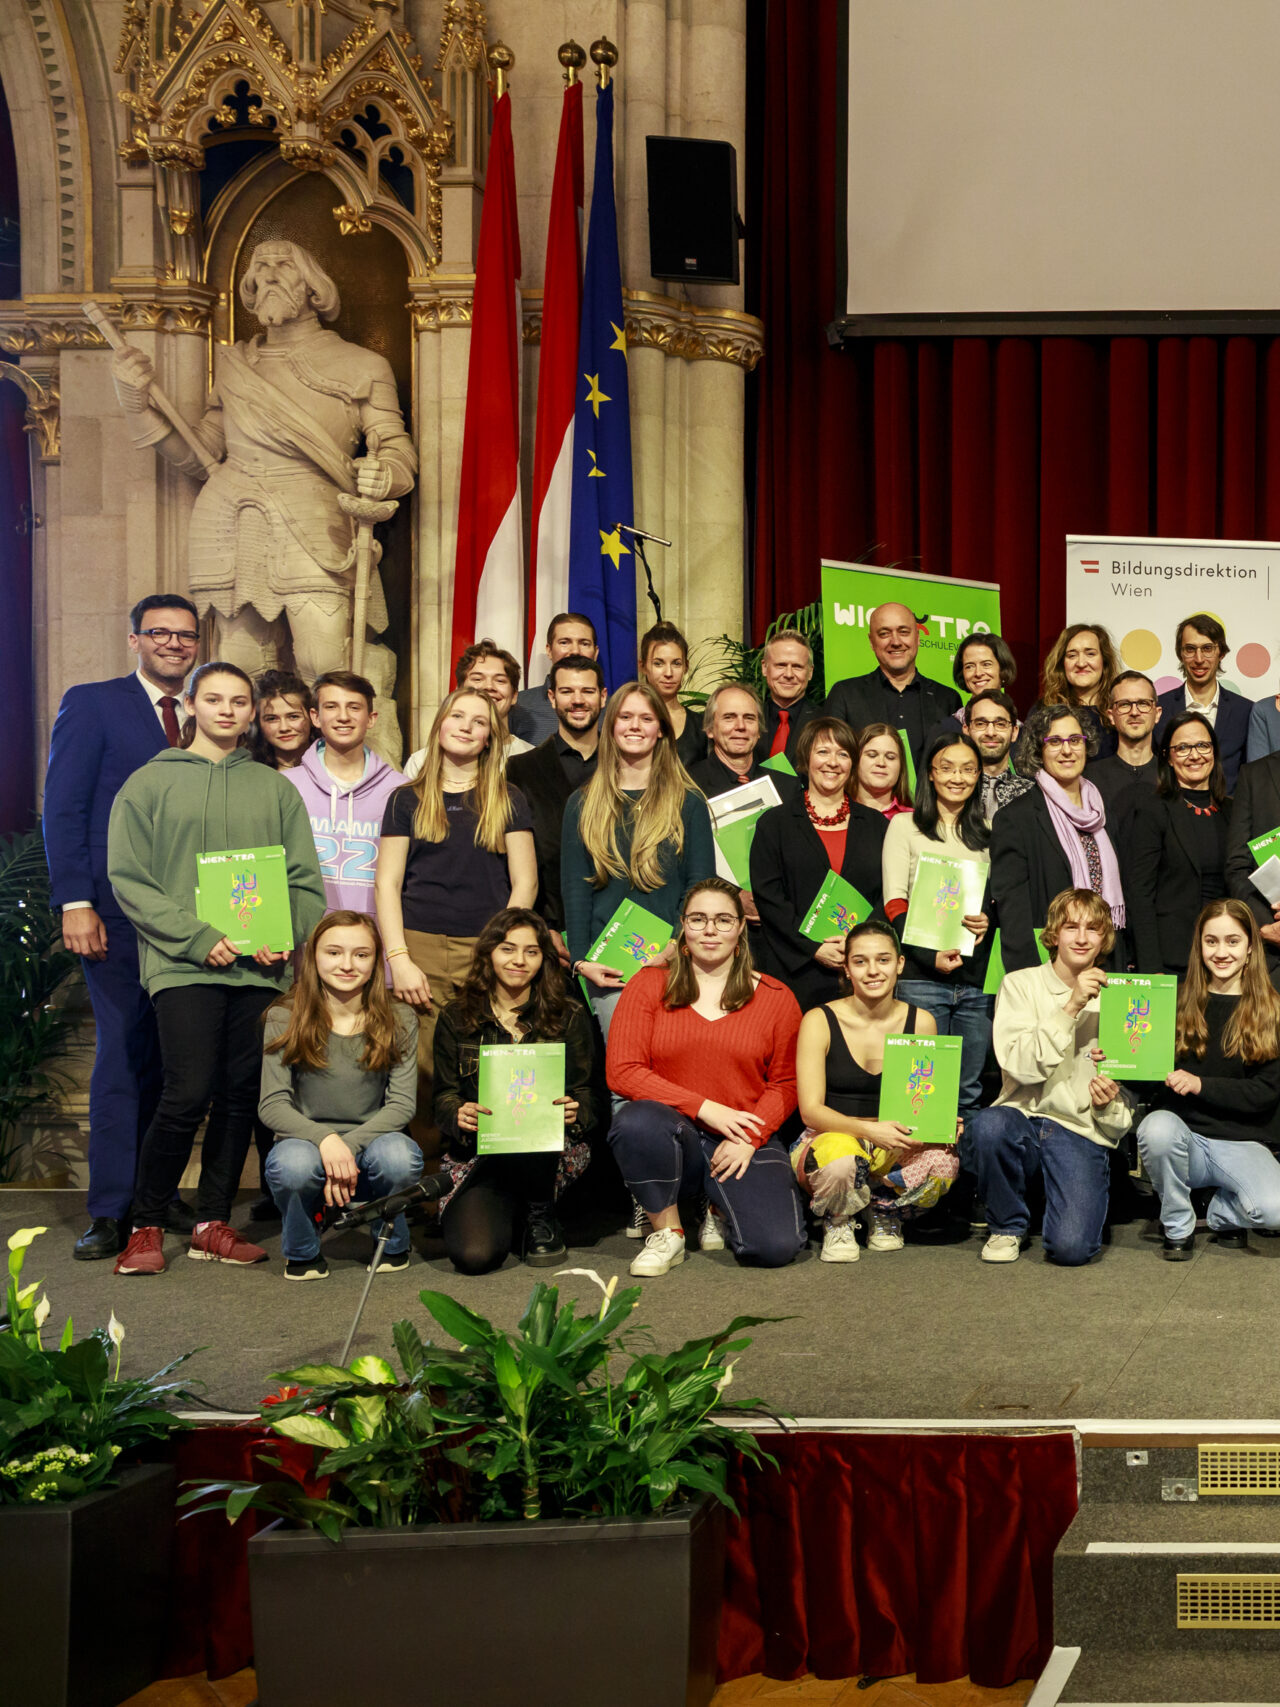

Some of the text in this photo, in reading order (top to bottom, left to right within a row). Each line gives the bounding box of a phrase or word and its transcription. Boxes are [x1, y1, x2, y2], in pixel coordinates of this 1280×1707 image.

[1111, 560, 1257, 580] Bildungsdirektion
[1111, 582, 1153, 597] Wien
[309, 815, 380, 838] MAMI
[199, 853, 255, 865] WIENXTRA
[313, 834, 379, 883] 22
[590, 920, 622, 962] WIENXTRA
[887, 1038, 936, 1047] WIENXTRA
